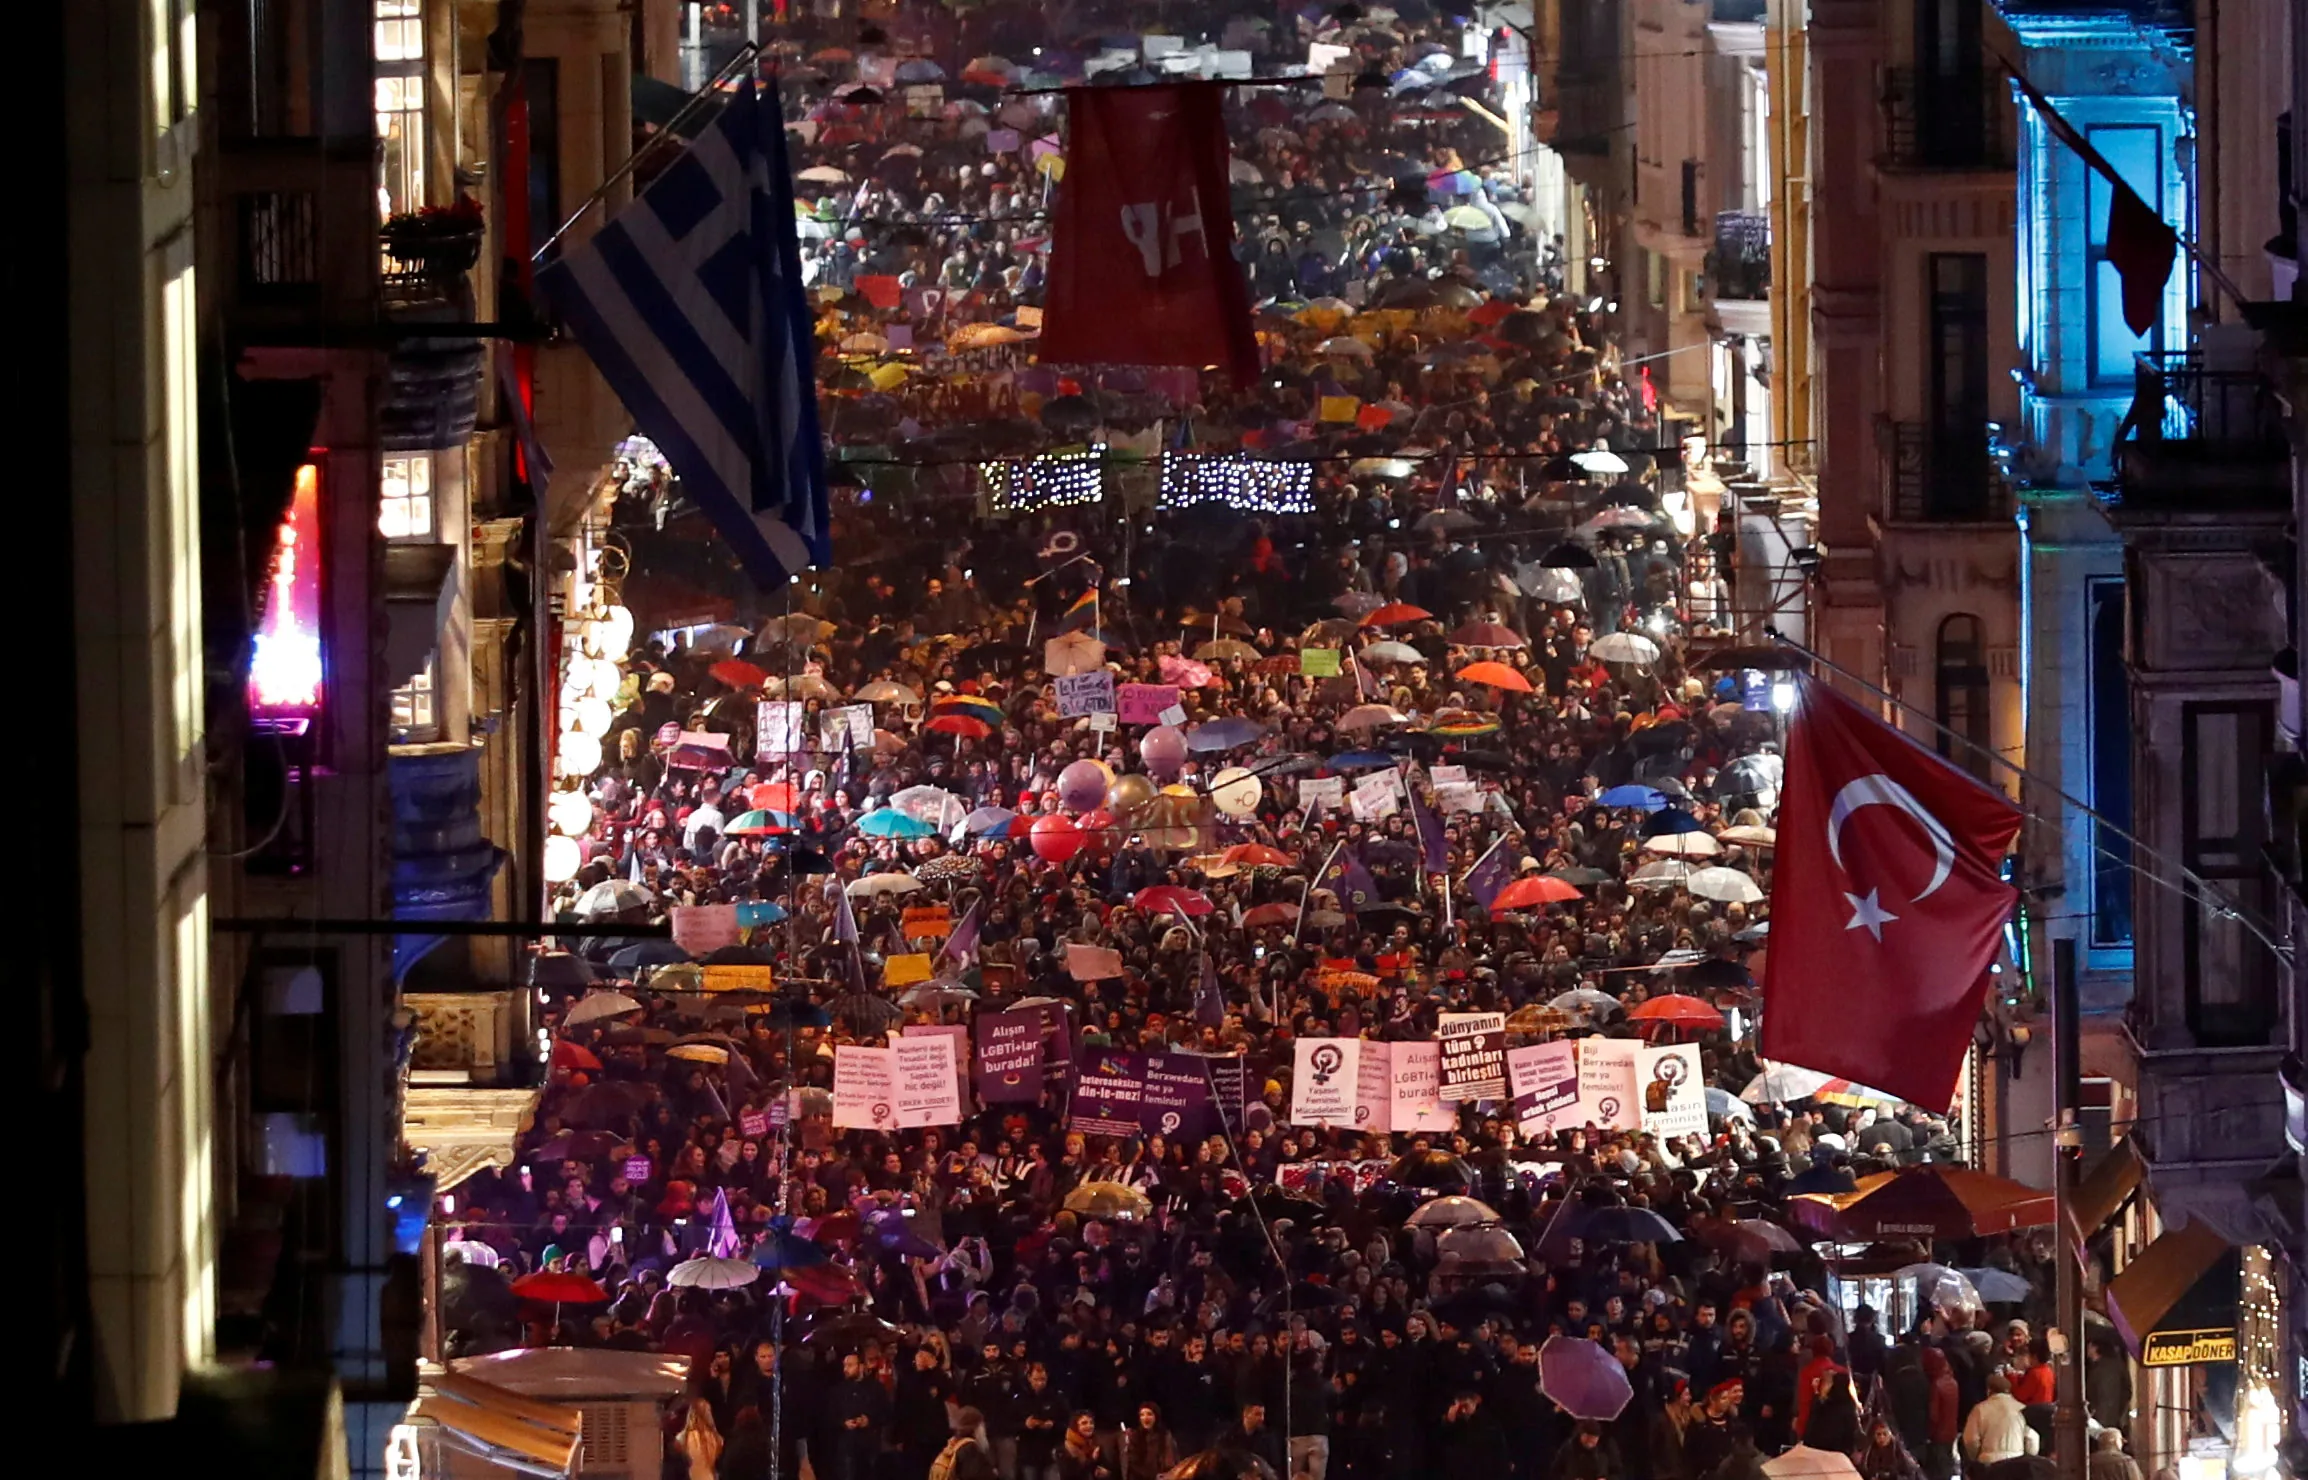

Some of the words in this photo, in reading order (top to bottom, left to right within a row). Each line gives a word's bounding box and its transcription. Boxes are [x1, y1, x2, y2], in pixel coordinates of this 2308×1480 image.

[992, 1025, 1025, 1038] Alışın
[1441, 1017, 1501, 1036] dünyanın
[1445, 1040, 1472, 1054] tüm
[985, 1054, 1035, 1073] burada!
[1441, 1050, 1504, 1070] kadınları
[1583, 1058, 1635, 1068] Berxwedan
[1447, 1062, 1503, 1084] birleşti!
[1078, 1086, 1141, 1101] din-le-mez!
[1644, 1113, 1705, 1127] Fminist
[2150, 1344, 2193, 1361] KASAP
[2193, 1343, 2234, 1360] DÖNER
